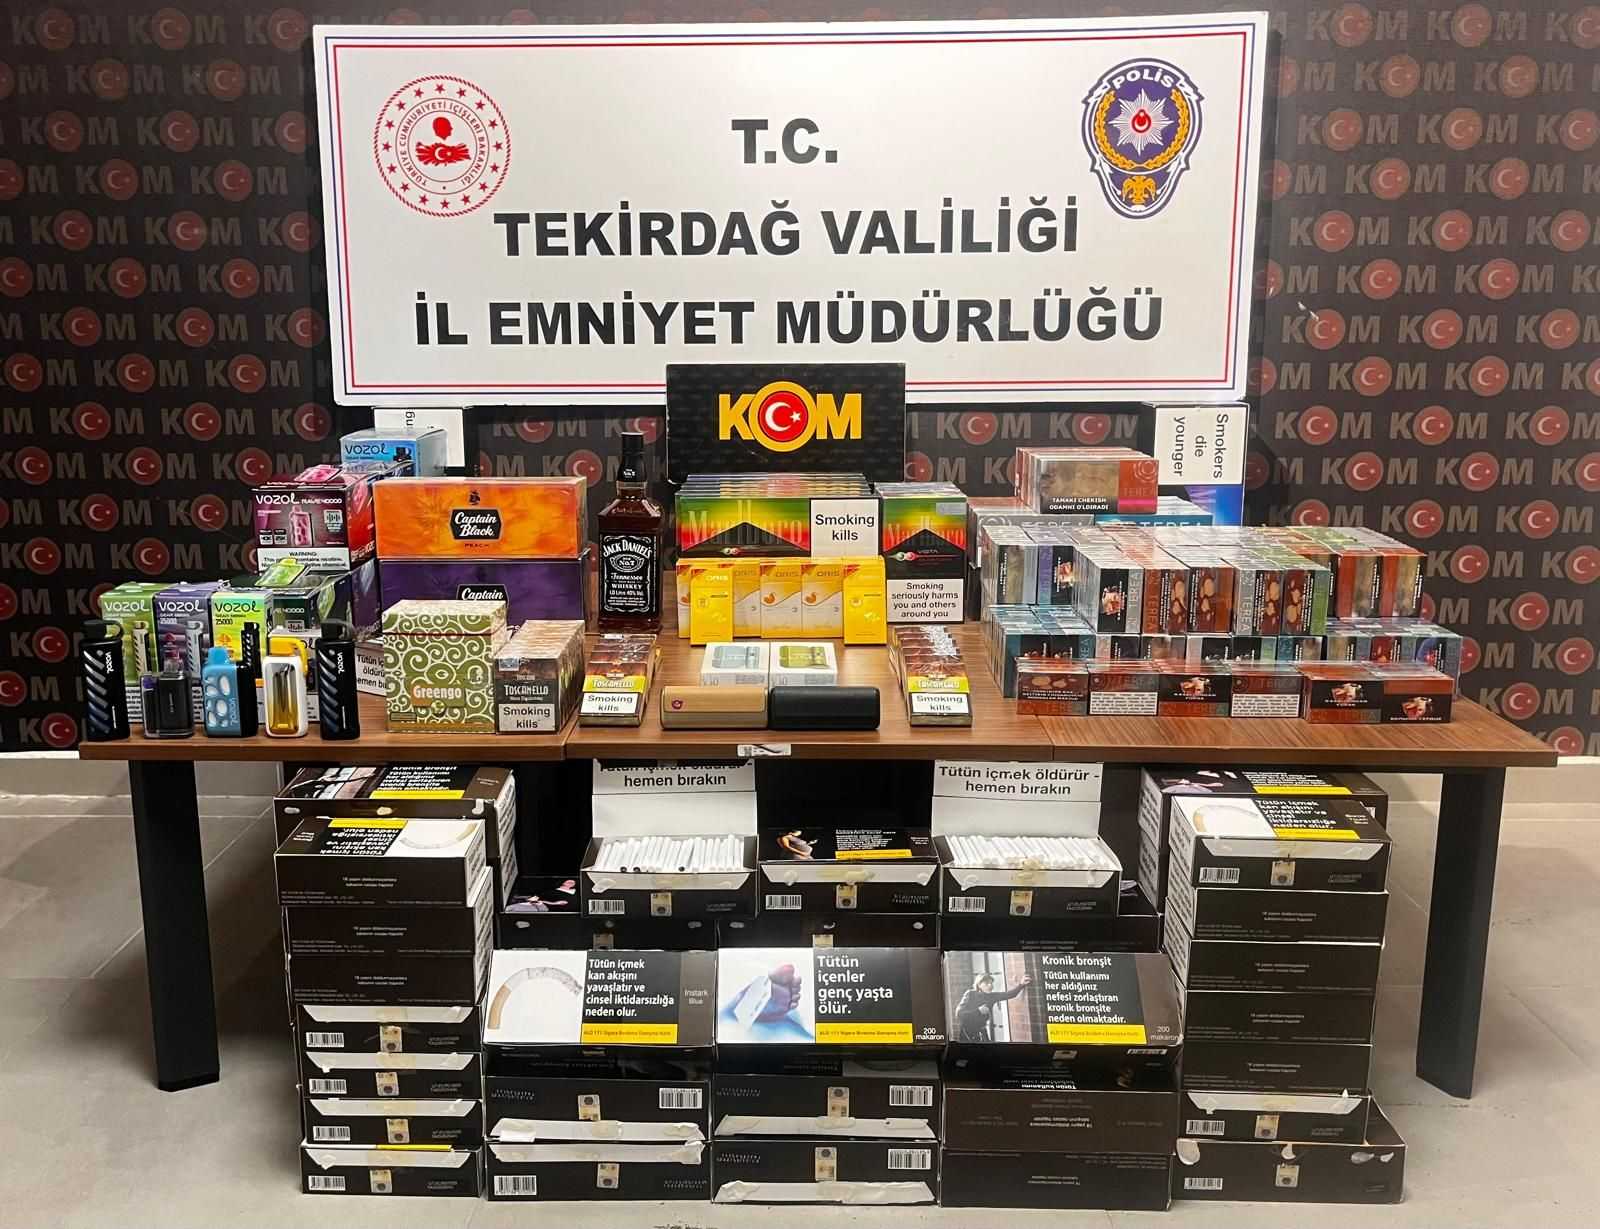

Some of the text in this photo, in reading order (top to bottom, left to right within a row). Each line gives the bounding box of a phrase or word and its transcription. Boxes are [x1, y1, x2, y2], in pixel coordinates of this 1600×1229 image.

[1111, 68, 1173, 90] POLİS
[400, 101, 446, 147] CUMHURİYETİ
[731, 118, 838, 164] T.C.
[400, 150, 428, 187] TÜRKİYE
[494, 195, 1078, 257] TEKİRDAĞ VALİLİĞİ
[415, 286, 1162, 345] İL EMNİYET MÜDÜRLÜĞÜ
[1171, 416, 1186, 477] younger
[1195, 435, 1207, 458] die
[1213, 413, 1229, 479] Smokers
[256, 492, 299, 505] VOZOL
[455, 511, 497, 526] Captain
[815, 514, 875, 528] Smoking
[459, 524, 494, 537] Black
[832, 529, 859, 541] kills
[603, 539, 653, 559] JACK DANIEL'S
[906, 582, 944, 592] Smoking
[461, 588, 504, 600] Captain
[892, 591, 959, 600] seriously harms
[104, 600, 150, 612] VOZOL
[159, 600, 204, 612] VOZOL
[214, 601, 260, 613] VOZOL
[893, 602, 909, 610] you
[929, 600, 956, 608] others
[901, 610, 949, 619] around you
[357, 677, 377, 688] emen
[413, 685, 462, 701] Greengo
[588, 695, 633, 704] Smoking
[916, 695, 963, 704] Smoking
[503, 707, 550, 718] Smoking
[598, 704, 619, 712] kills
[516, 719, 538, 729] kills
[939, 765, 981, 780] Tütün
[986, 766, 1031, 782] içmek
[1036, 767, 1088, 781] öldürür
[624, 774, 727, 788] hemen bırakın
[965, 782, 1071, 795] hemen bırakın
[589, 958, 645, 971] Tütün içmek
[817, 955, 859, 968] Tütün
[1042, 956, 1112, 968] Kronik bronşit
[588, 970, 637, 982] kan akışını
[817, 970, 865, 986] içenler
[1044, 971, 1109, 981] Tütün kullanımı
[586, 982, 645, 996] yavaşlatır ve
[1045, 981, 1097, 993] her aldığınız
[586, 993, 674, 1007] cinsel iktidarsızlığa
[817, 986, 893, 1003] genç yaşta
[1046, 992, 1119, 1004] nefesi zorlaştıran
[585, 1006, 637, 1017] neden olur.
[817, 1001, 851, 1015] ölür.
[1047, 1003, 1111, 1015] kronik bronşite
[1048, 1014, 1126, 1025] neden olmaktadır.
